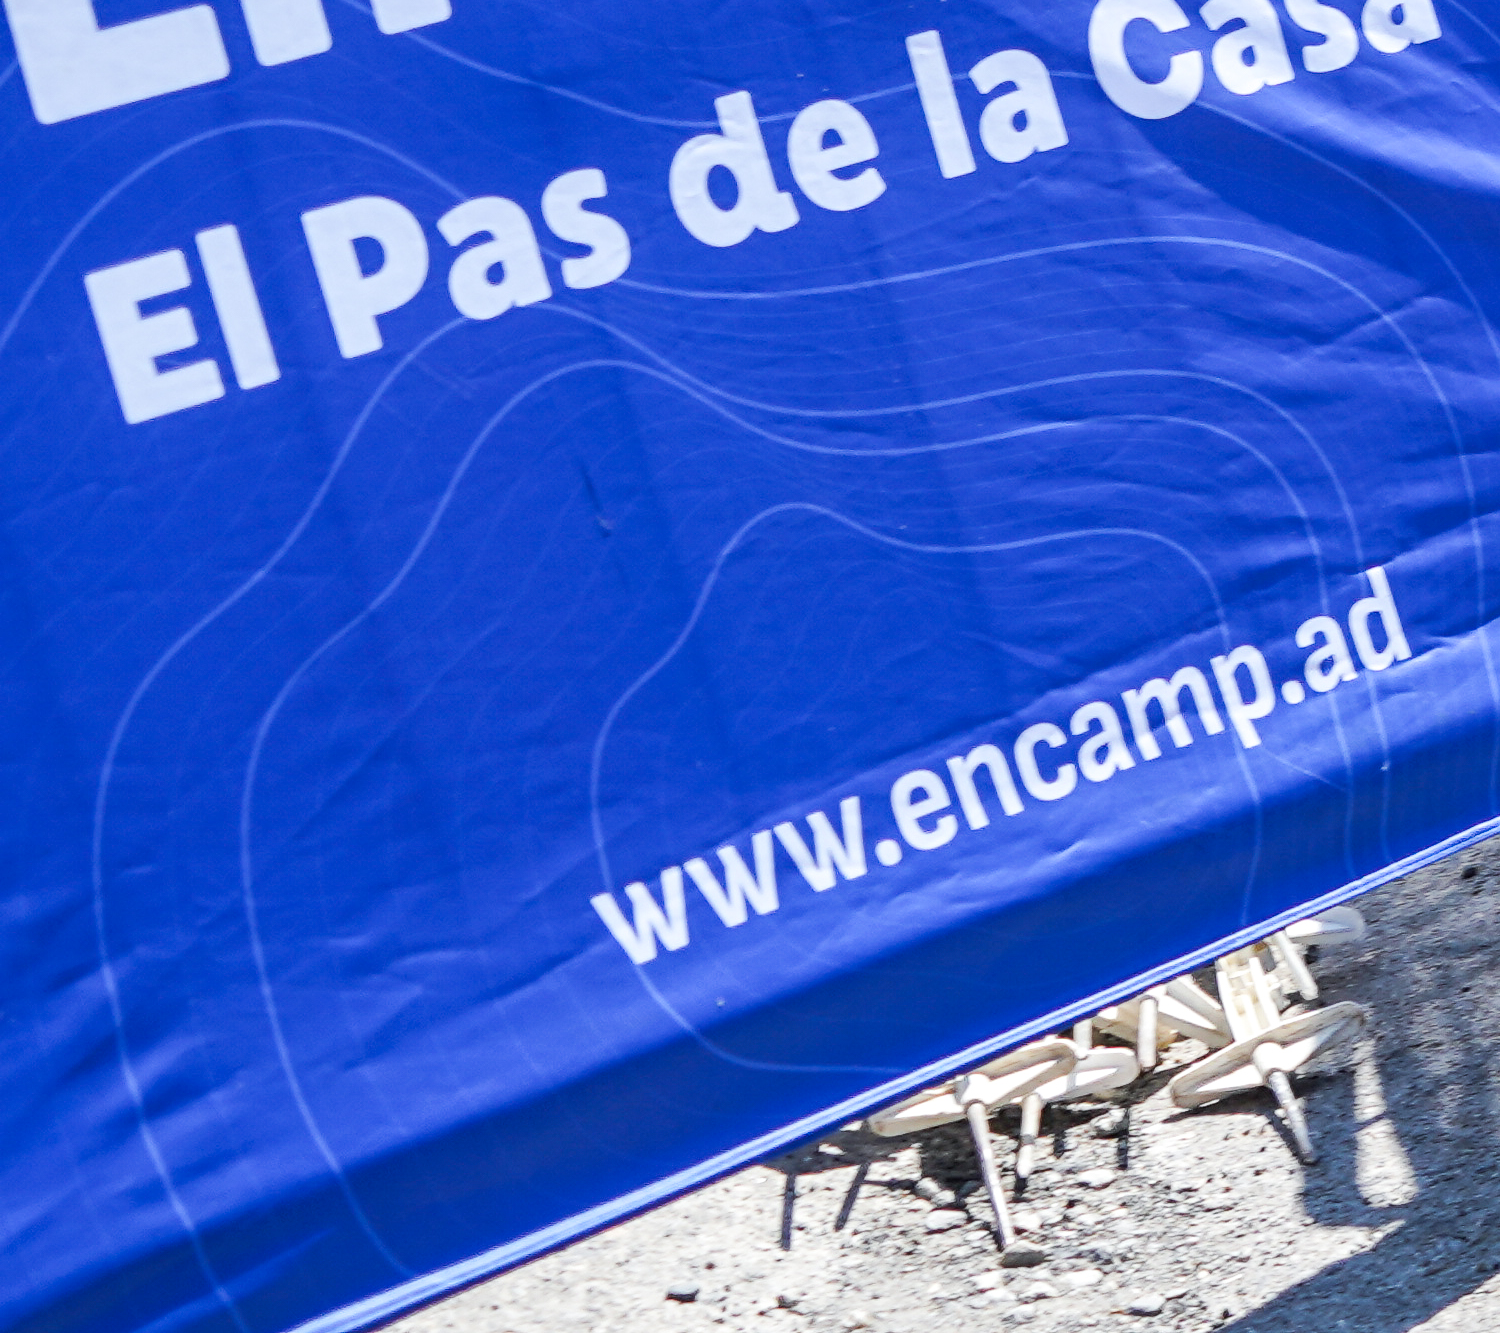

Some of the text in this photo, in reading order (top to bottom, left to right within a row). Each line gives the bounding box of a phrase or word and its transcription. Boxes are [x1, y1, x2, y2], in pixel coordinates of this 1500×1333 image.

[84, 224, 281, 424] El
[301, 194, 631, 359] Pas
[668, 90, 886, 248] de
[906, 29, 1069, 179] la
[590, 566, 1413, 966] www.encamp.ad
